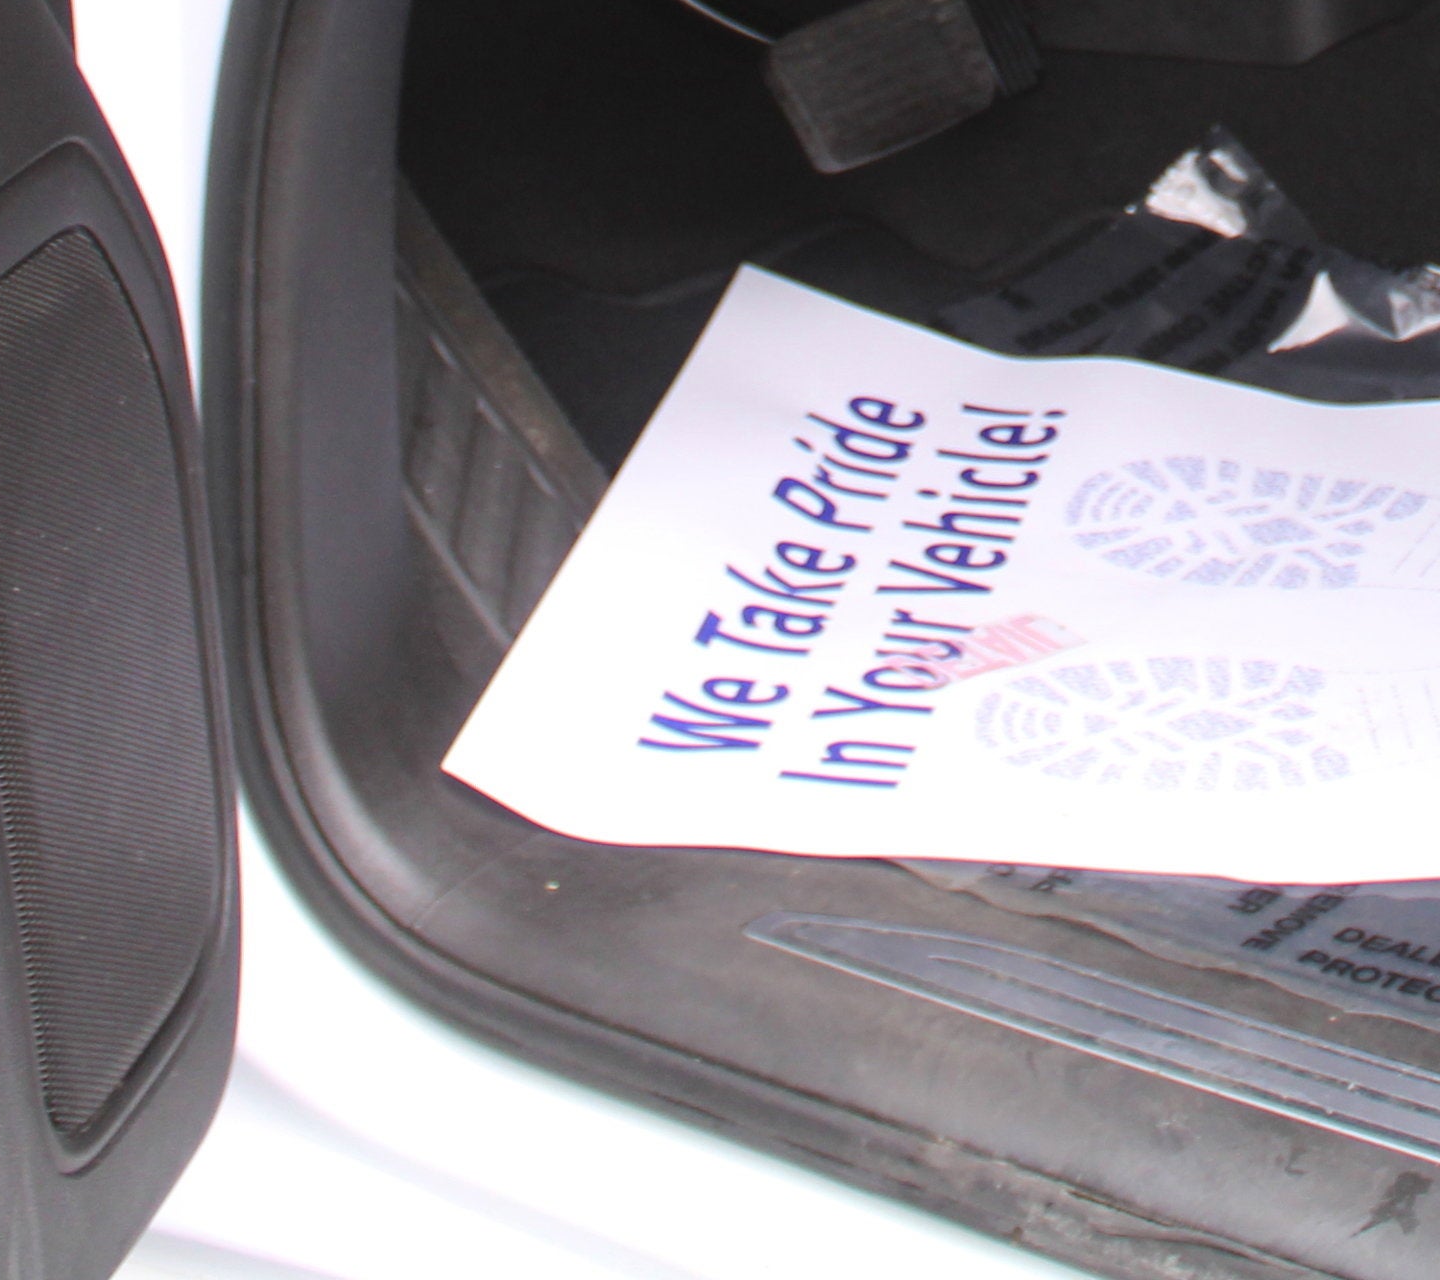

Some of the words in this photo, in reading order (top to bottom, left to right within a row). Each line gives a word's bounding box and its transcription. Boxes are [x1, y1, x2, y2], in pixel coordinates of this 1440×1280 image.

[771, 395, 926, 533] Pride
[875, 402, 1068, 594] Vehicle!
[694, 540, 857, 657] Take
[637, 676, 790, 752] We
[811, 608, 975, 718] Your
[778, 740, 916, 789] In
